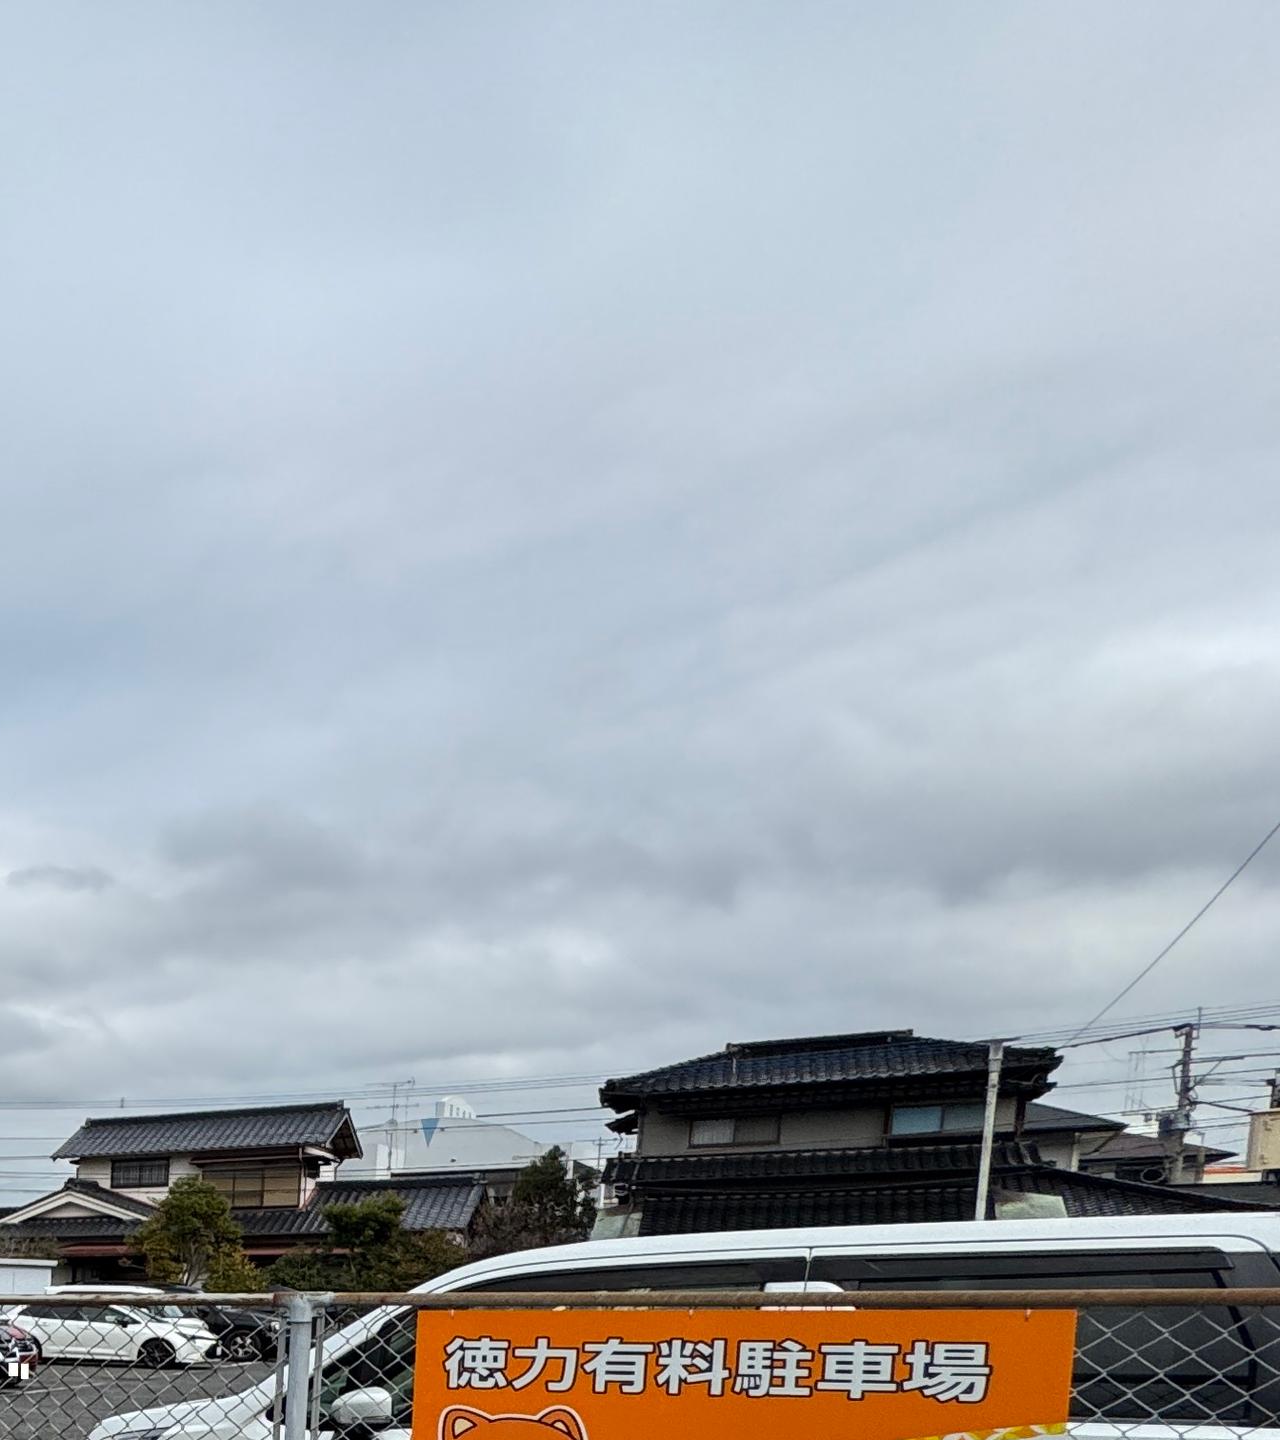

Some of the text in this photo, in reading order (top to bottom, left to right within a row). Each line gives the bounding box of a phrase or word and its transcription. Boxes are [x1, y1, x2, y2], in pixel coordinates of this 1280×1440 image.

[443, 1337, 993, 1403] 徳力有料駐車場
